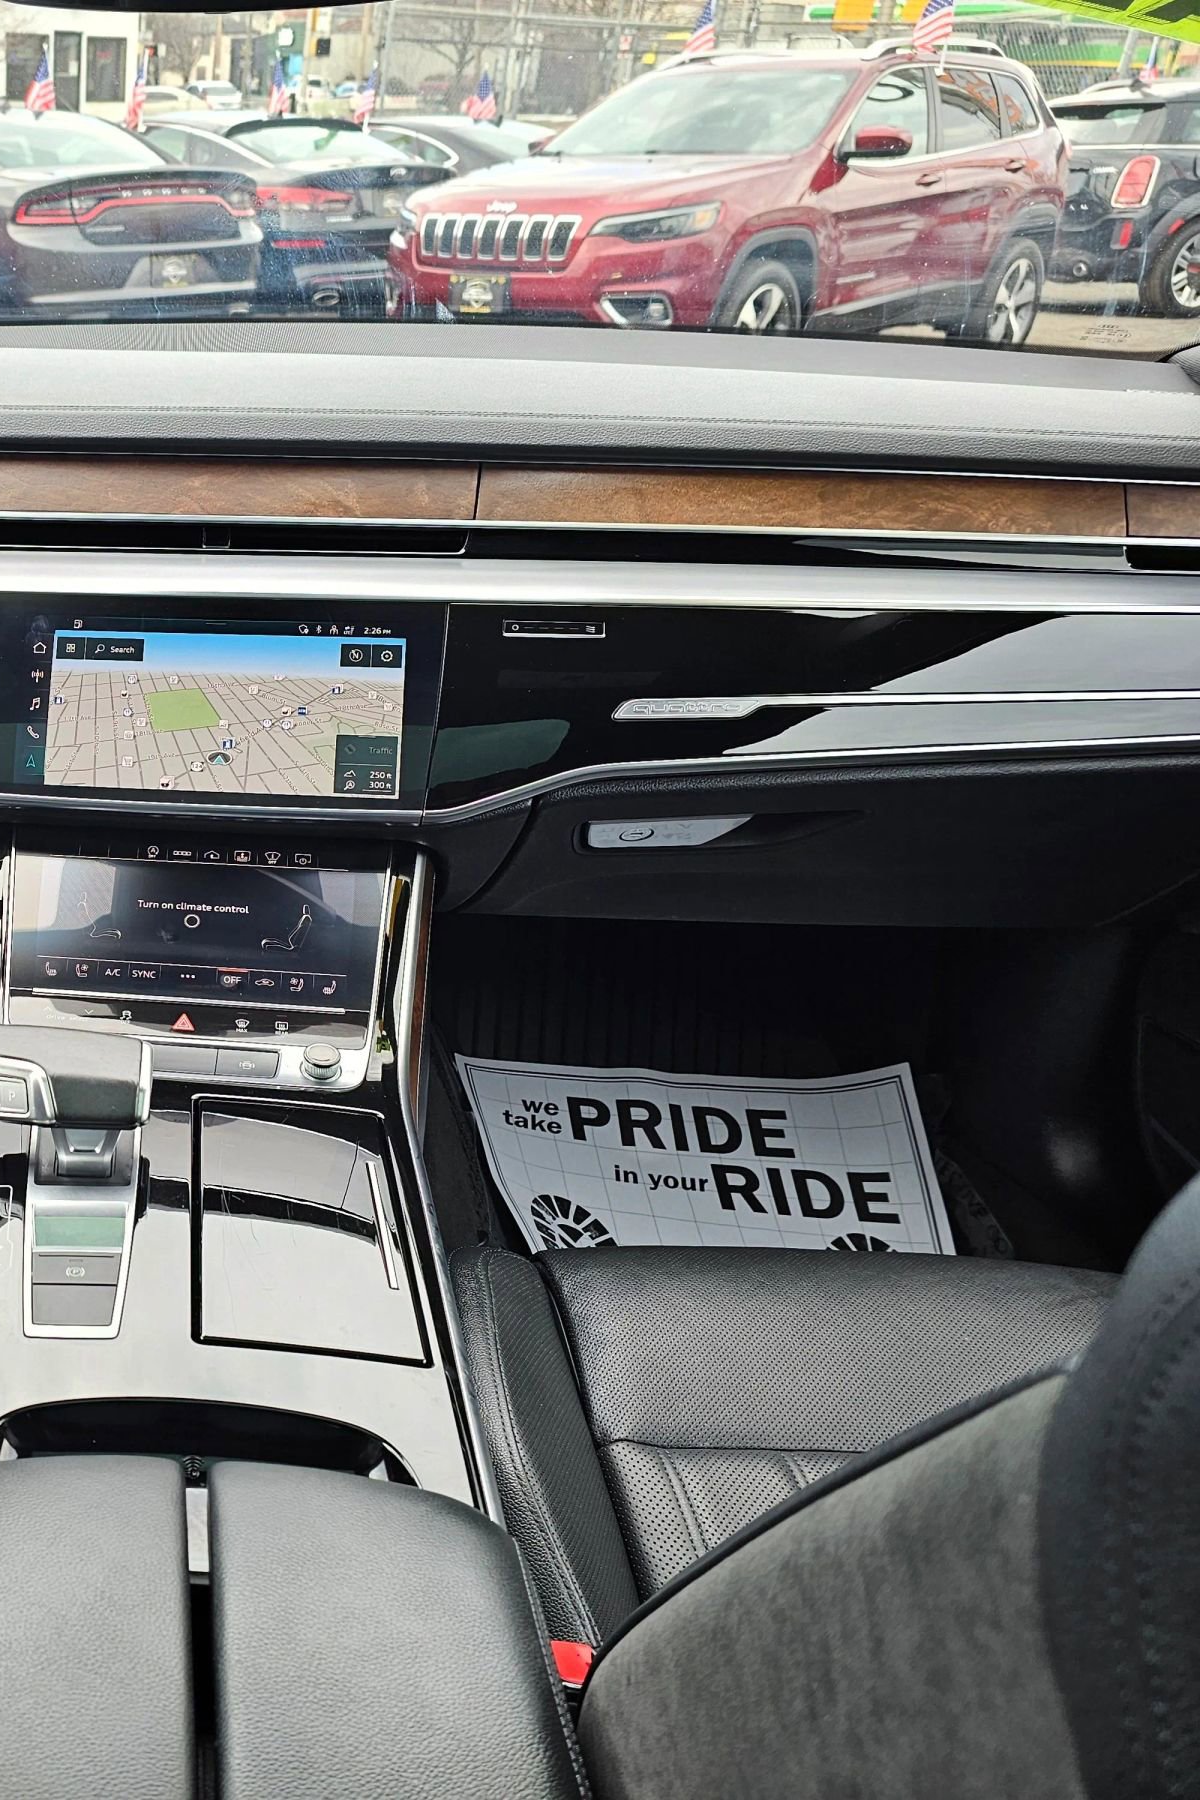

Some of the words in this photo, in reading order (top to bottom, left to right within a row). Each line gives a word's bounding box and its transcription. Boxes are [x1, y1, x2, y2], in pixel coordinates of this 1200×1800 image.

[363, 627, 382, 635] 2:26
[110, 645, 135, 654] Search
[632, 702, 742, 715] quattro
[369, 747, 393, 755] Traffic
[369, 771, 385, 779] 250
[369, 781, 385, 789] 300
[137, 899, 159, 909] Turn
[161, 902, 174, 910] on
[176, 902, 212, 912] climate
[214, 903, 250, 914] control
[105, 968, 121, 977] A/C
[132, 969, 157, 979] SYNC
[223, 975, 242, 984] OFF
[9, 1091, 16, 1101] P
[522, 1099, 559, 1116] we
[502, 1109, 562, 1134] take
[566, 1096, 796, 1158] PRIDE
[614, 1165, 639, 1184] in
[648, 1174, 709, 1192] your
[710, 1163, 901, 1224] RIDE
